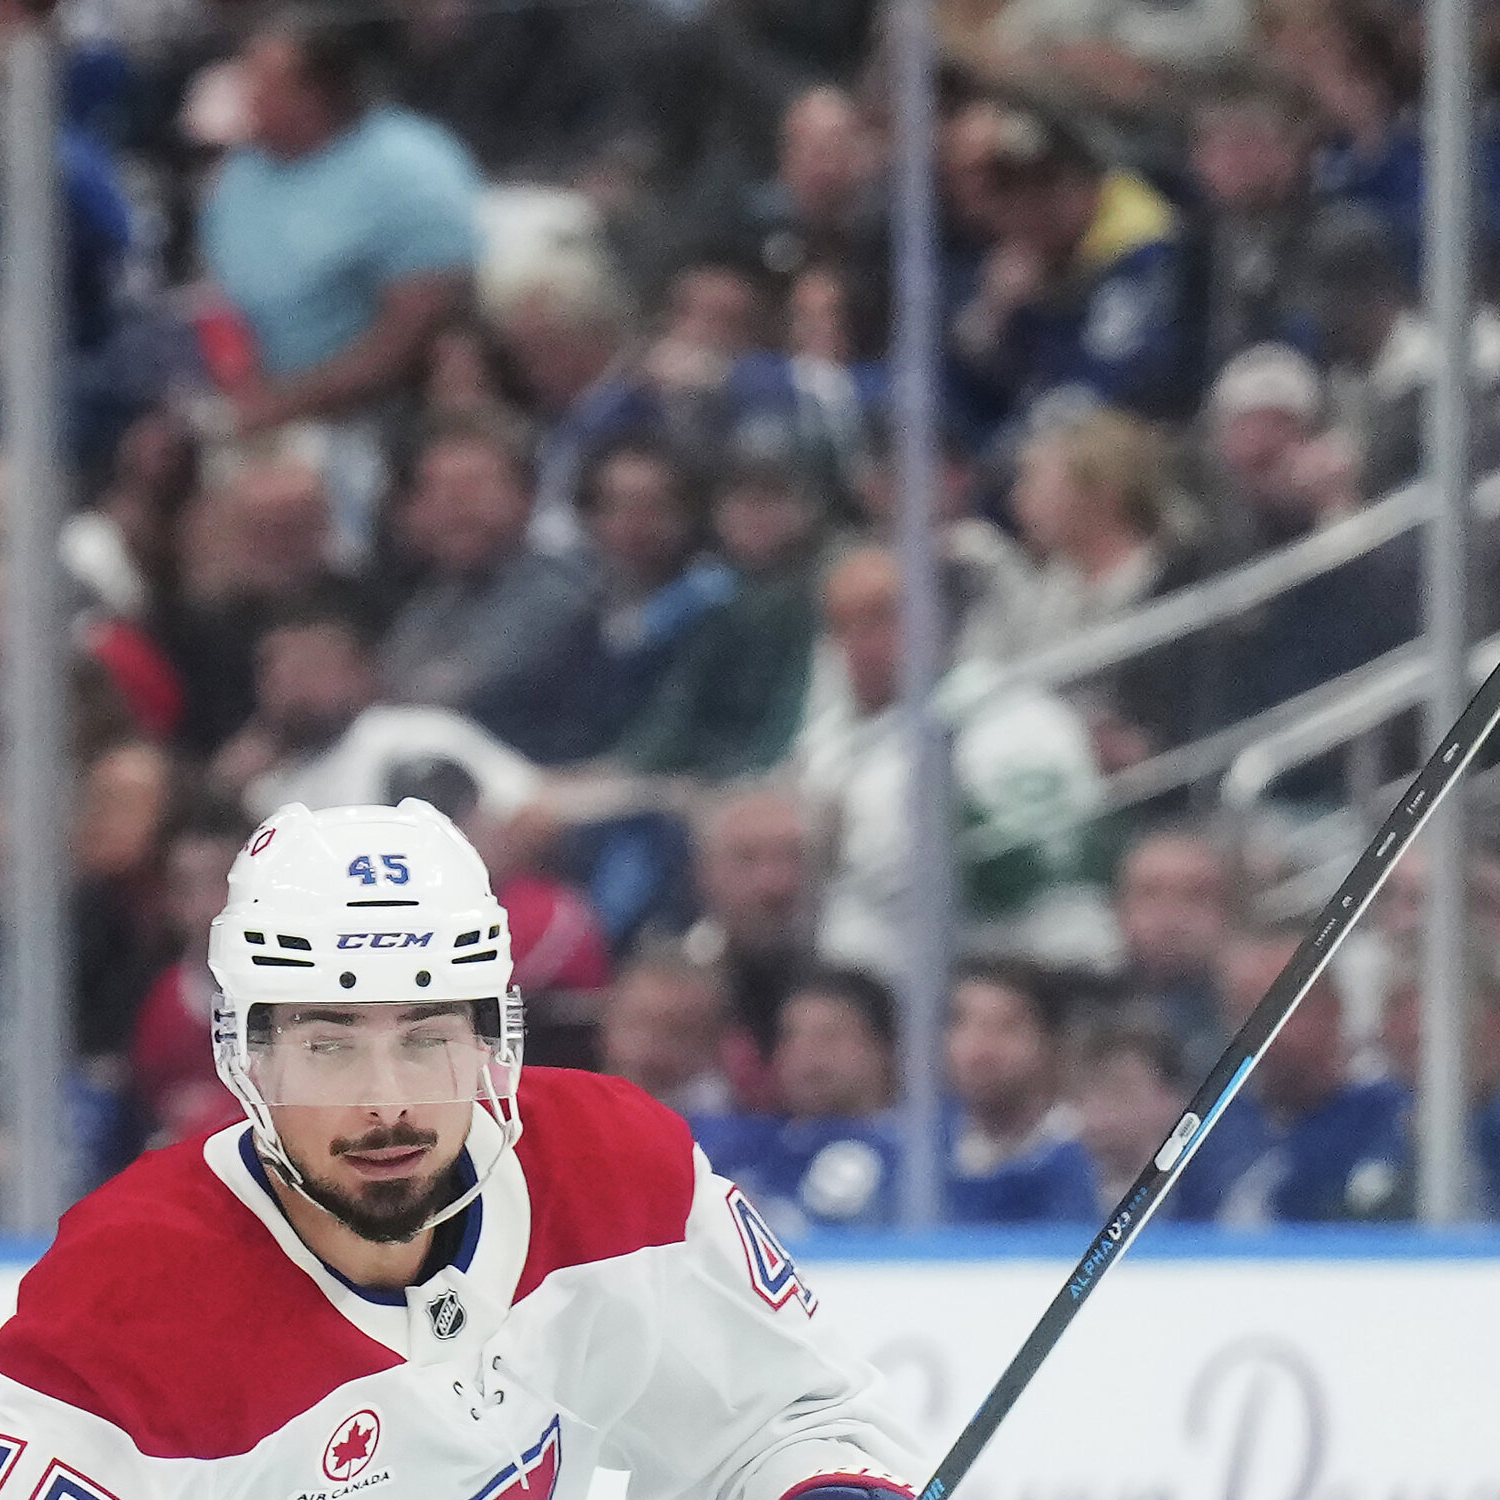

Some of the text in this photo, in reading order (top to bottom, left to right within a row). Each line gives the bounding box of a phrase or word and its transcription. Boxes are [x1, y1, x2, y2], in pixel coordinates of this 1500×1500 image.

[348, 854, 410, 885] 45
[336, 931, 435, 950] CCM
[1069, 1239, 1114, 1300] ALPHA
[296, 1471, 390, 1500] AIR CANADA
